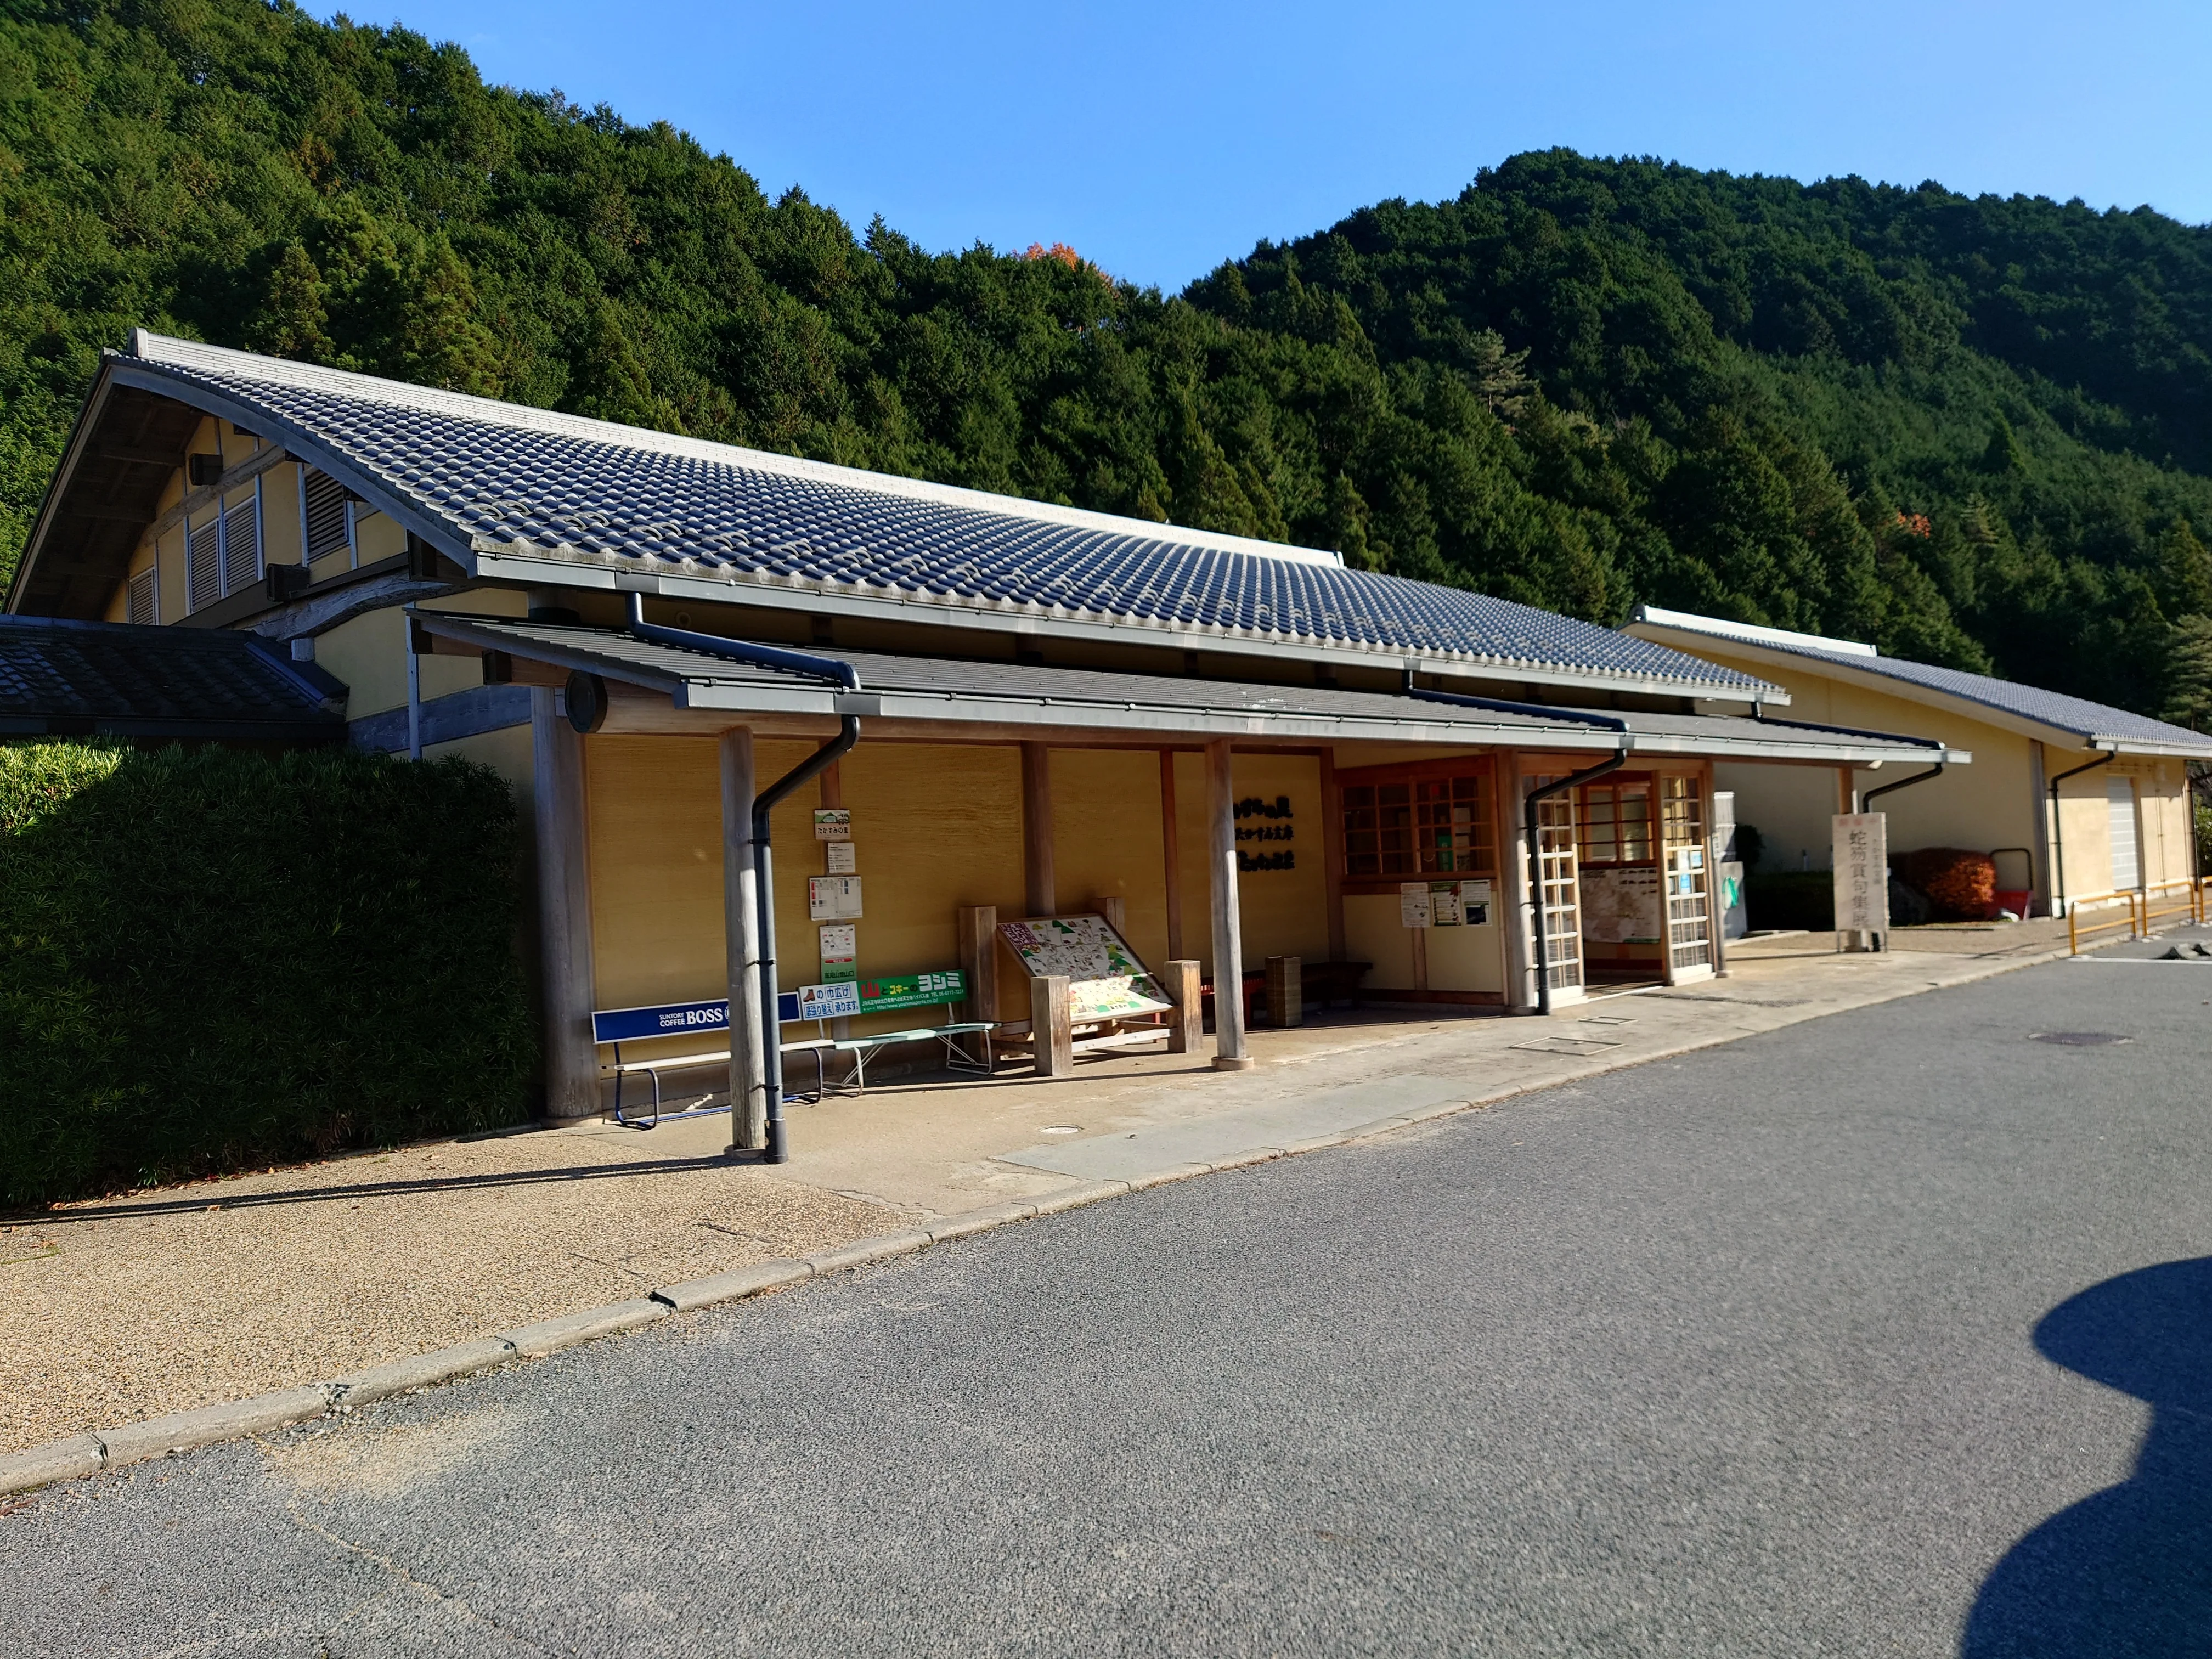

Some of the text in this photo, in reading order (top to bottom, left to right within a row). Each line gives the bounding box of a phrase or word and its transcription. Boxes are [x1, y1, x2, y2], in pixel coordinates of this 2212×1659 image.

[1849, 830, 1868, 927] 蛇笏賞句集展
[817, 986, 849, 1000] の 巾広げ
[659, 1012, 685, 1020] SUNTORY
[805, 1000, 859, 1017] 底張り替え 承ります。
[659, 1018, 685, 1027] COFFEE
[686, 1008, 724, 1025] BOSS
